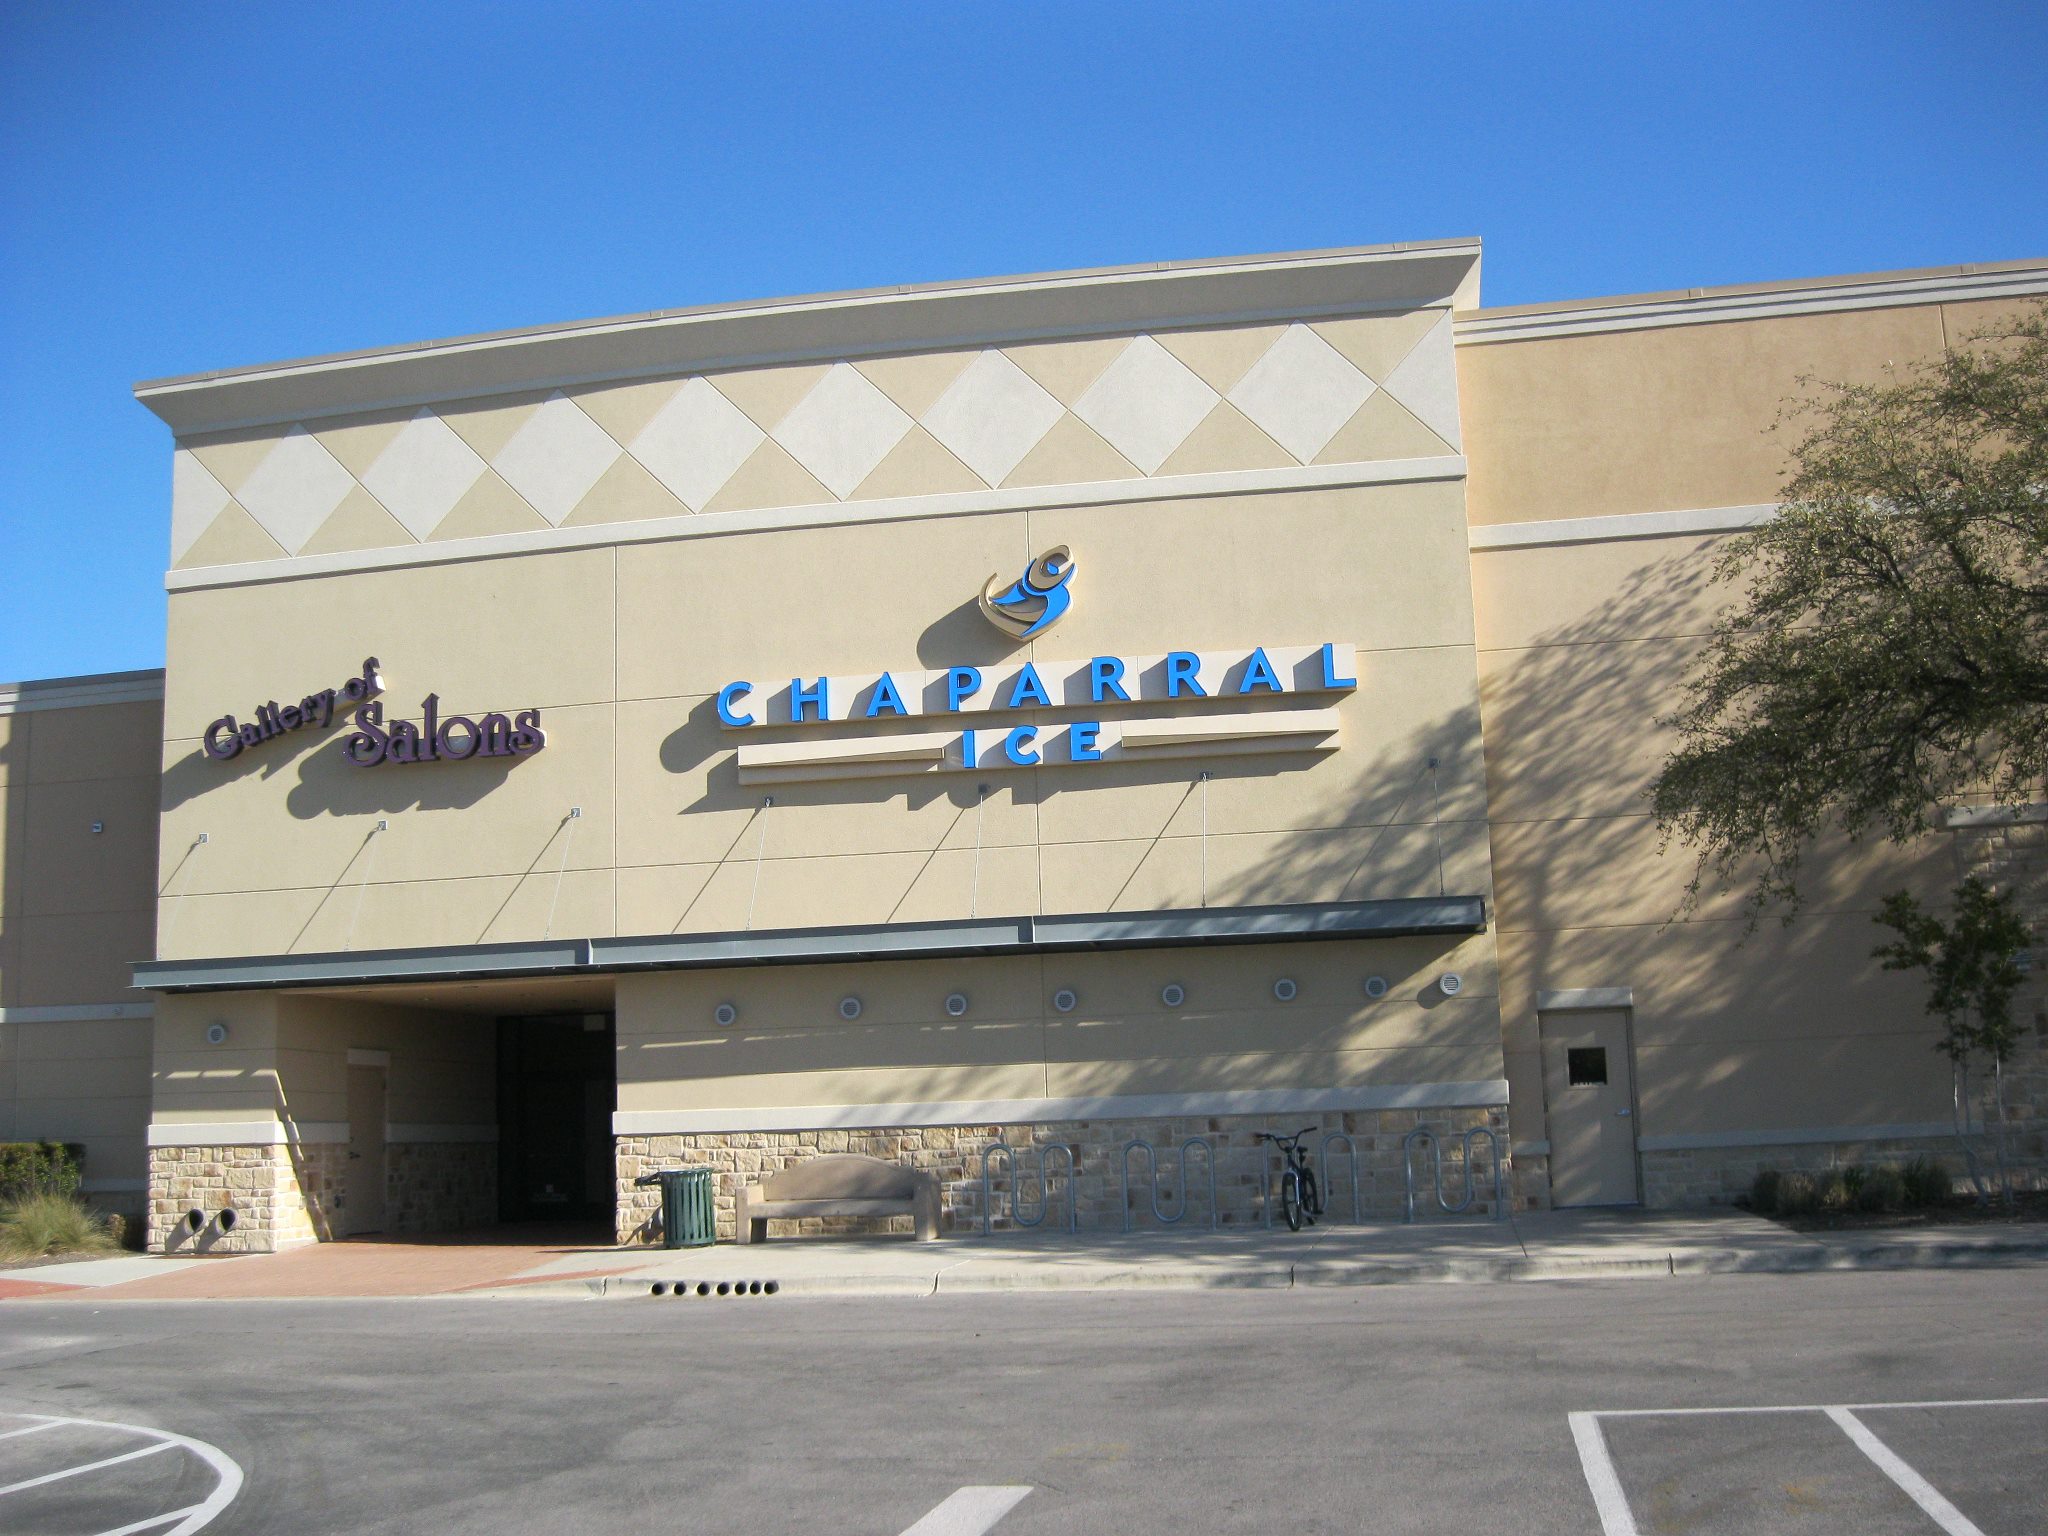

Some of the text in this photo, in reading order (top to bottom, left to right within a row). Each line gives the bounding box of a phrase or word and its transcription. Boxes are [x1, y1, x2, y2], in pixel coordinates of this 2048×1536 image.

[204, 656, 386, 760] Gallery of
[716, 642, 1357, 727] CHAPARRAL
[343, 692, 548, 767] Salons
[962, 721, 1101, 768] ICE
